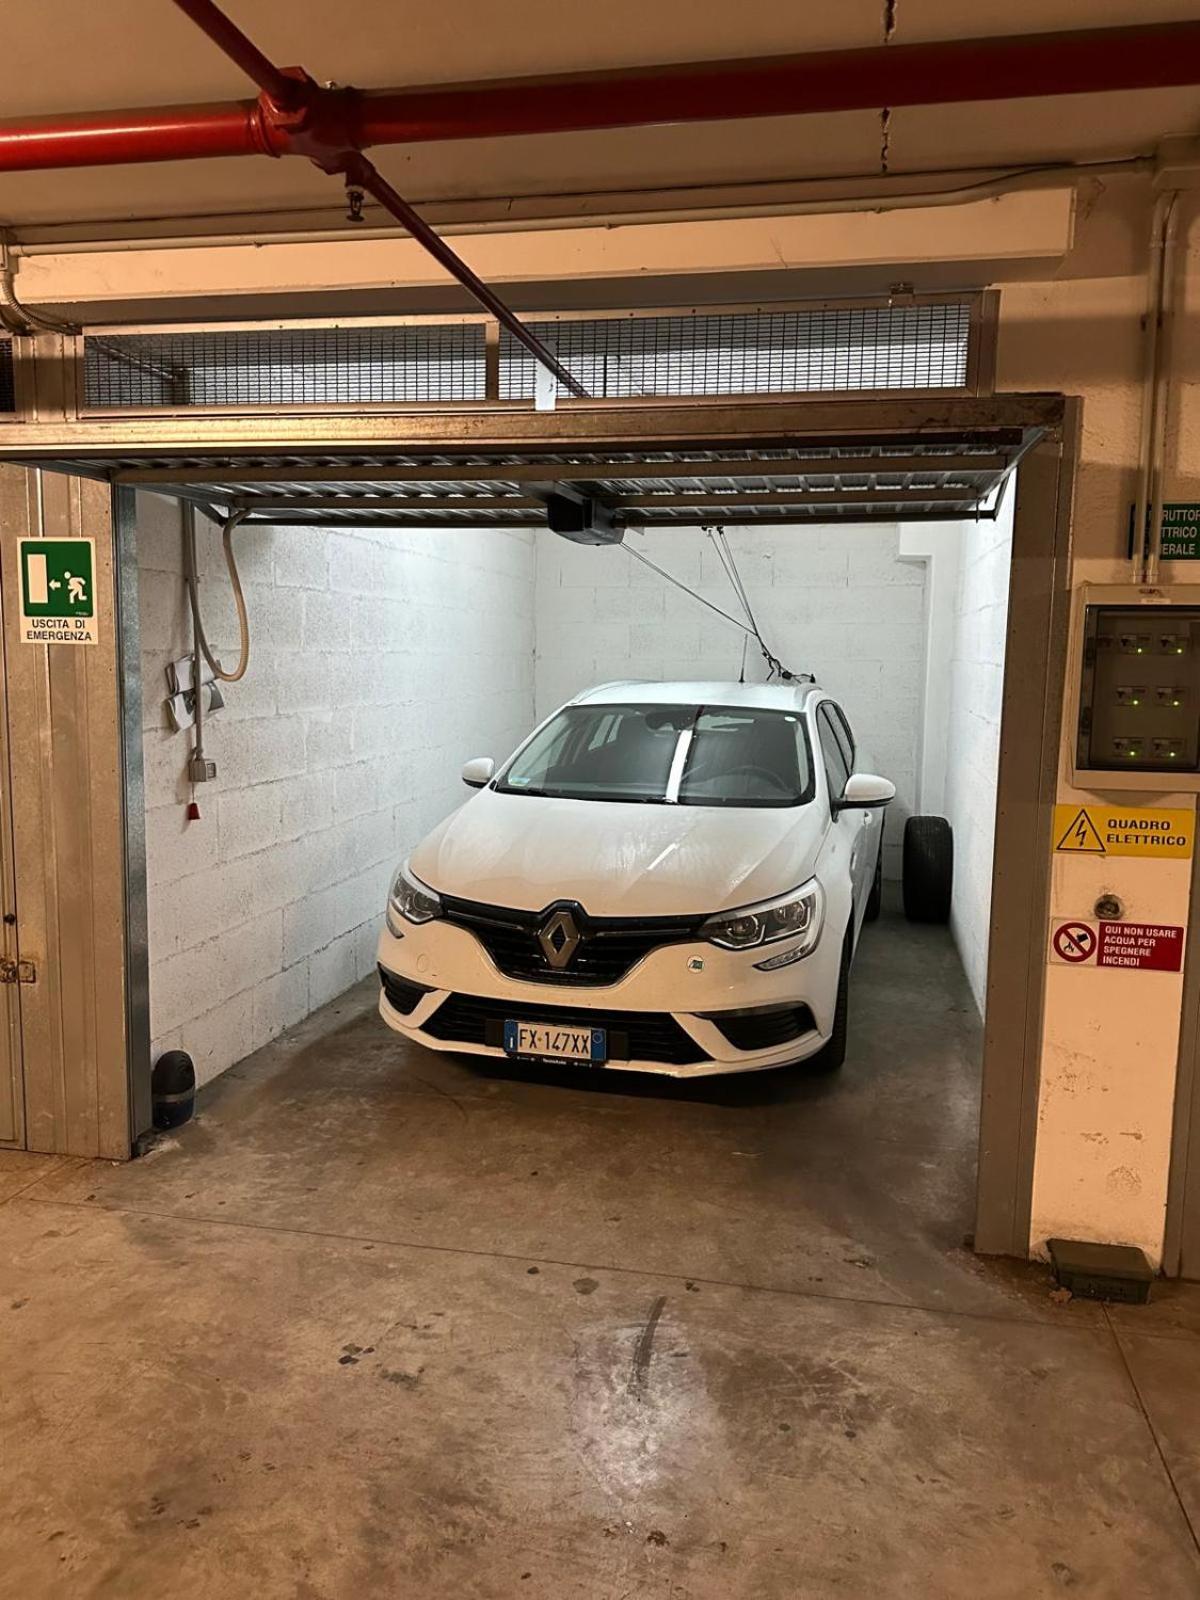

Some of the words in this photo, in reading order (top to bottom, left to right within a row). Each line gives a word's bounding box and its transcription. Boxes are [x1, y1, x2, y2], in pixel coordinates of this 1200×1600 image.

[32, 619, 69, 629] USCITA
[75, 619, 85, 629] DI
[27, 631, 92, 641] EMERGENZA
[1107, 819, 1171, 831] QUADRO
[1106, 833, 1187, 846] ELETTRICO
[1105, 925, 1122, 935] QUI
[1123, 926, 1144, 936] NON
[1146, 928, 1177, 939] USARE
[1104, 937, 1135, 946] ACQUA
[1137, 938, 1156, 947] PER
[1103, 945, 1152, 957] SPEGNERE
[1102, 956, 1140, 967] INCENDI
